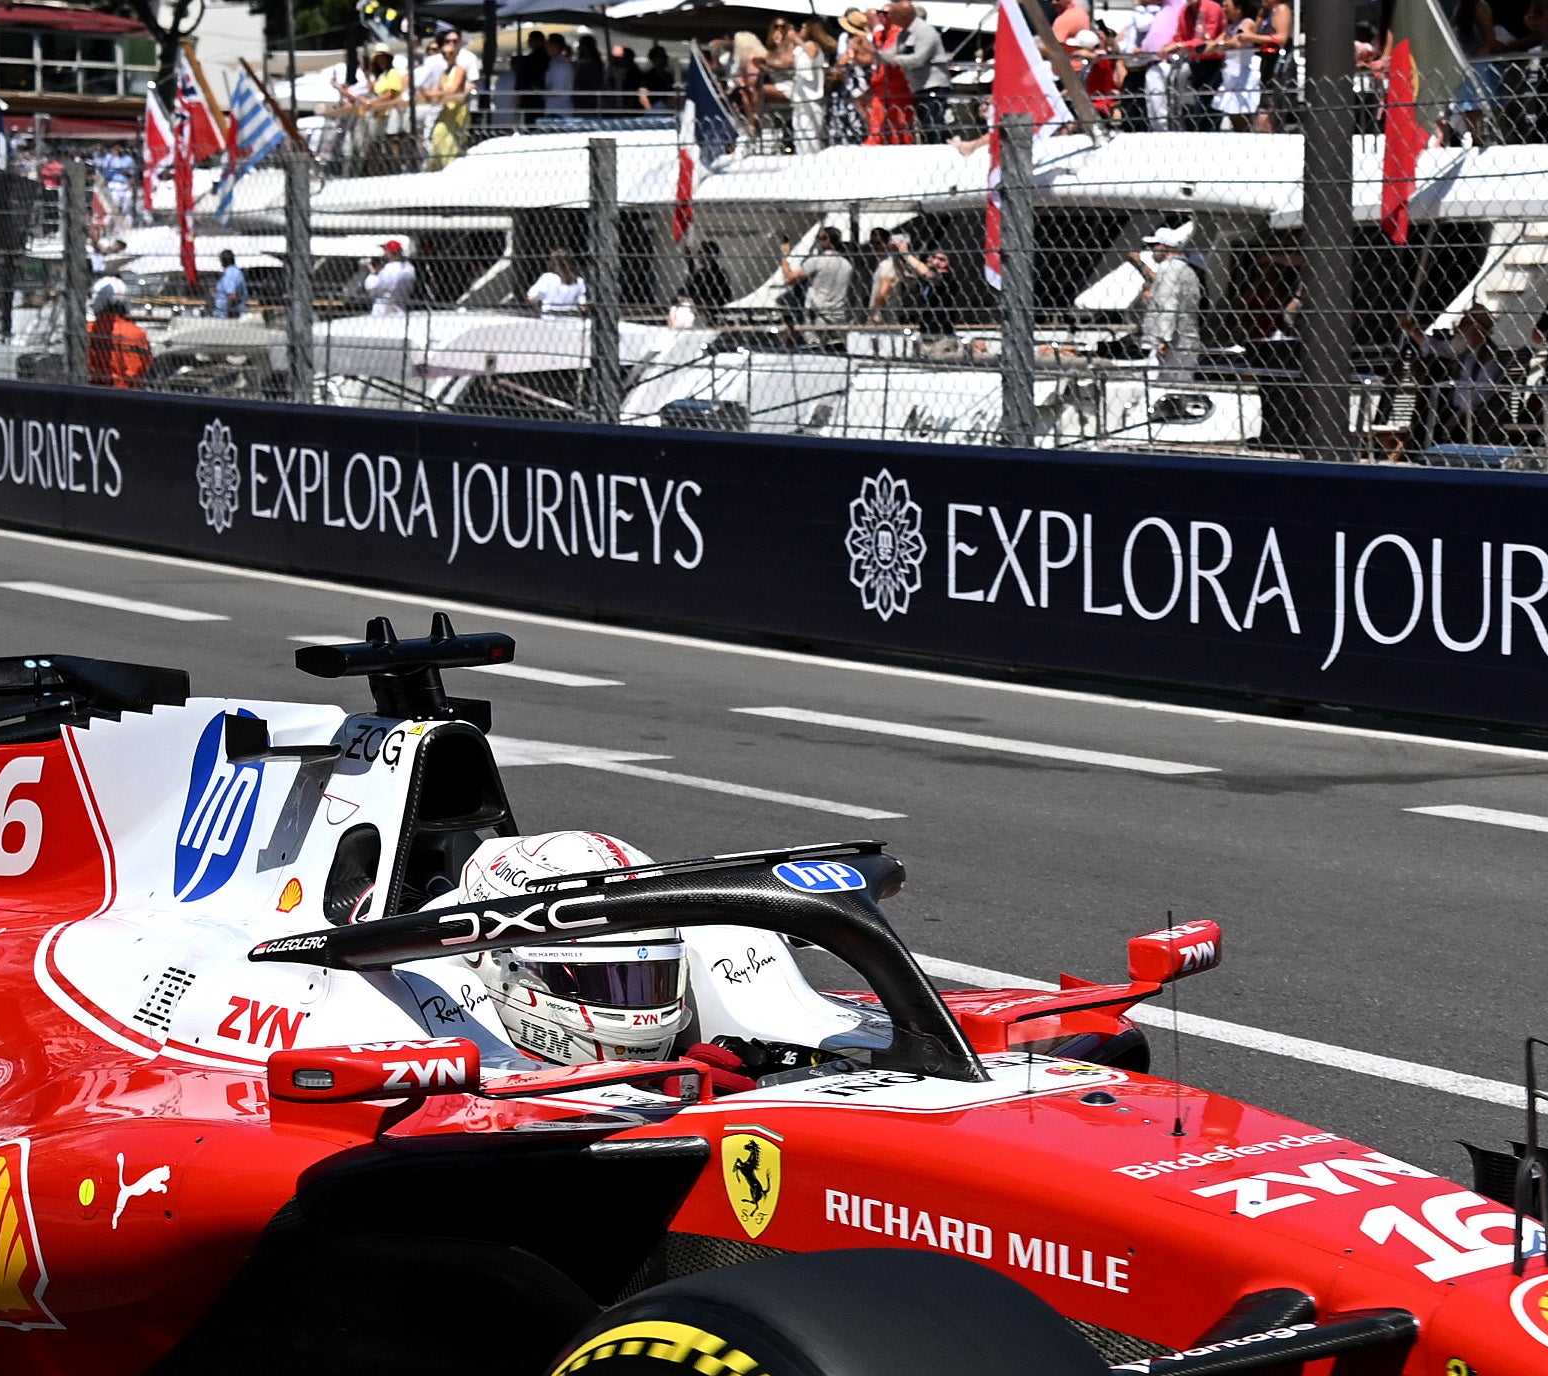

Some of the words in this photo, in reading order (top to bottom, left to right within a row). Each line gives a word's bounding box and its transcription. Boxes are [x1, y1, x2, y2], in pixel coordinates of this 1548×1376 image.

[251, 443, 438, 538] EXPLORA
[446, 462, 704, 571] JOURNEYS
[947, 503, 1302, 634] EXPLORA
[345, 724, 405, 767] ZCG
[175, 711, 259, 903] hp
[788, 860, 852, 891] hp
[438, 894, 609, 947] DXC
[1178, 940, 1215, 972] ZYN
[216, 995, 307, 1050] ZYN
[520, 1019, 574, 1060] IBM
[632, 1013, 659, 1026] ZYN
[381, 1056, 467, 1091] ZYN
[780, 1049, 798, 1066] 16
[1111, 1132, 1343, 1181] Bitdefender
[1190, 1151, 1440, 1219] ZYN
[825, 1187, 994, 1262] RICHARD
[1008, 1230, 1130, 1295] MILLE
[1358, 1190, 1548, 1283] 16
